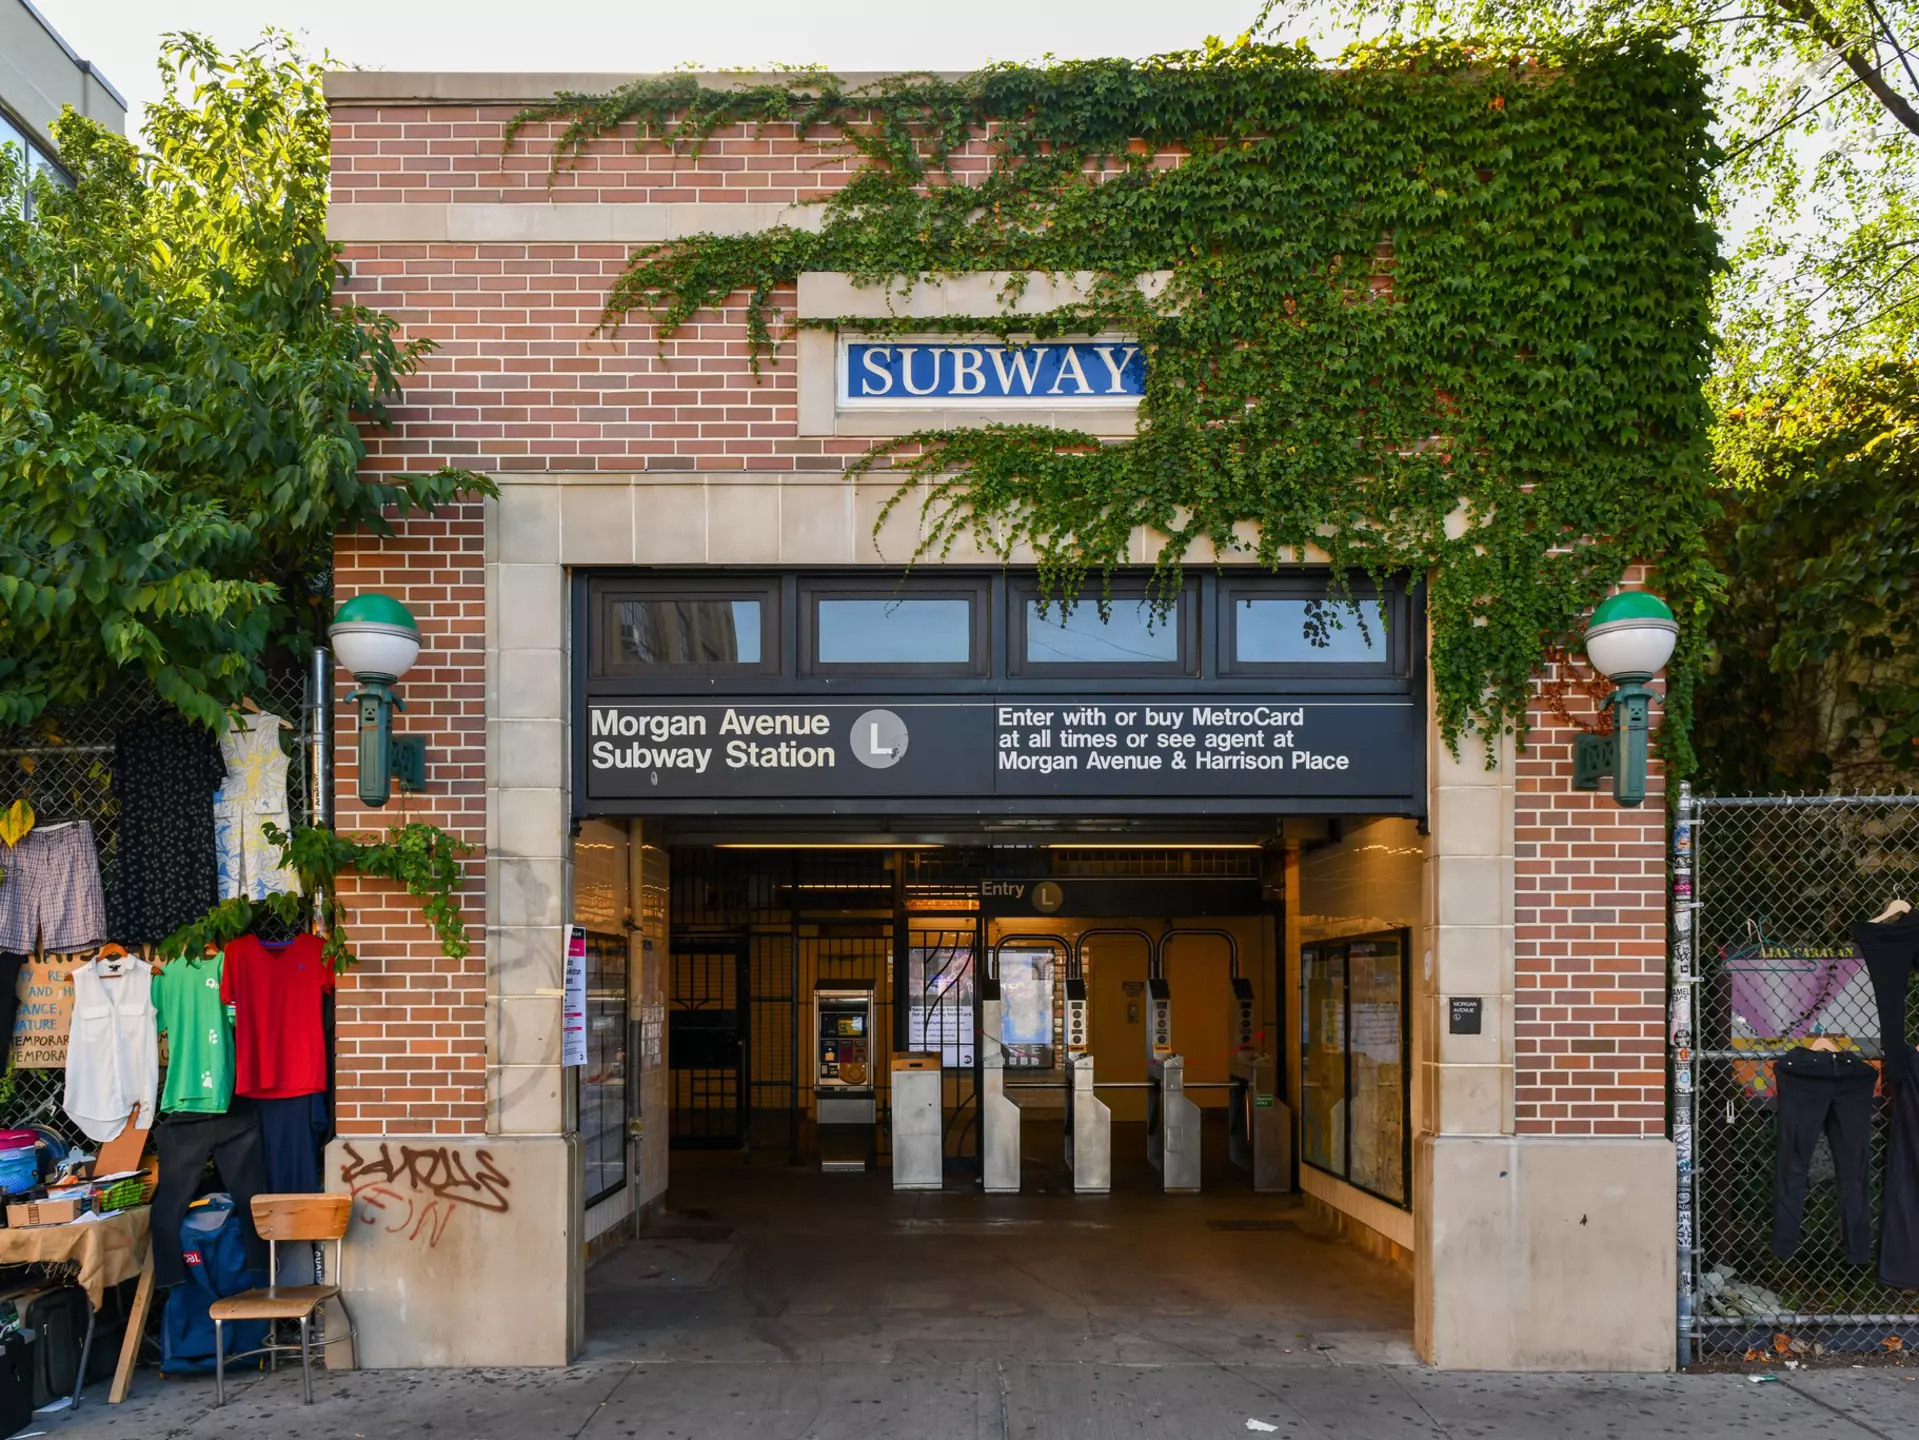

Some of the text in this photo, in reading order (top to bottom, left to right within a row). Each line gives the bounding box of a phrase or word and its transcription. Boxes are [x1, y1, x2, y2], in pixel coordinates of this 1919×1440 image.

[862, 346, 1140, 395] SUBWAY
[591, 709, 830, 742] Morgan Avenue
[999, 708, 1304, 729] Enter with or buy MetroCard
[870, 723, 893, 754] L
[999, 729, 1294, 751] at all times or see agent at
[591, 740, 836, 773] Subway Station
[999, 751, 1350, 773] Morgan Avenue & Harrison Place
[982, 881, 1025, 898] Entry
[1041, 888, 1054, 905] L
[28, 986, 54, 997] AND
[11, 1035, 70, 1046] TEMPORAR
[12, 1050, 66, 1062] TEMPORA
